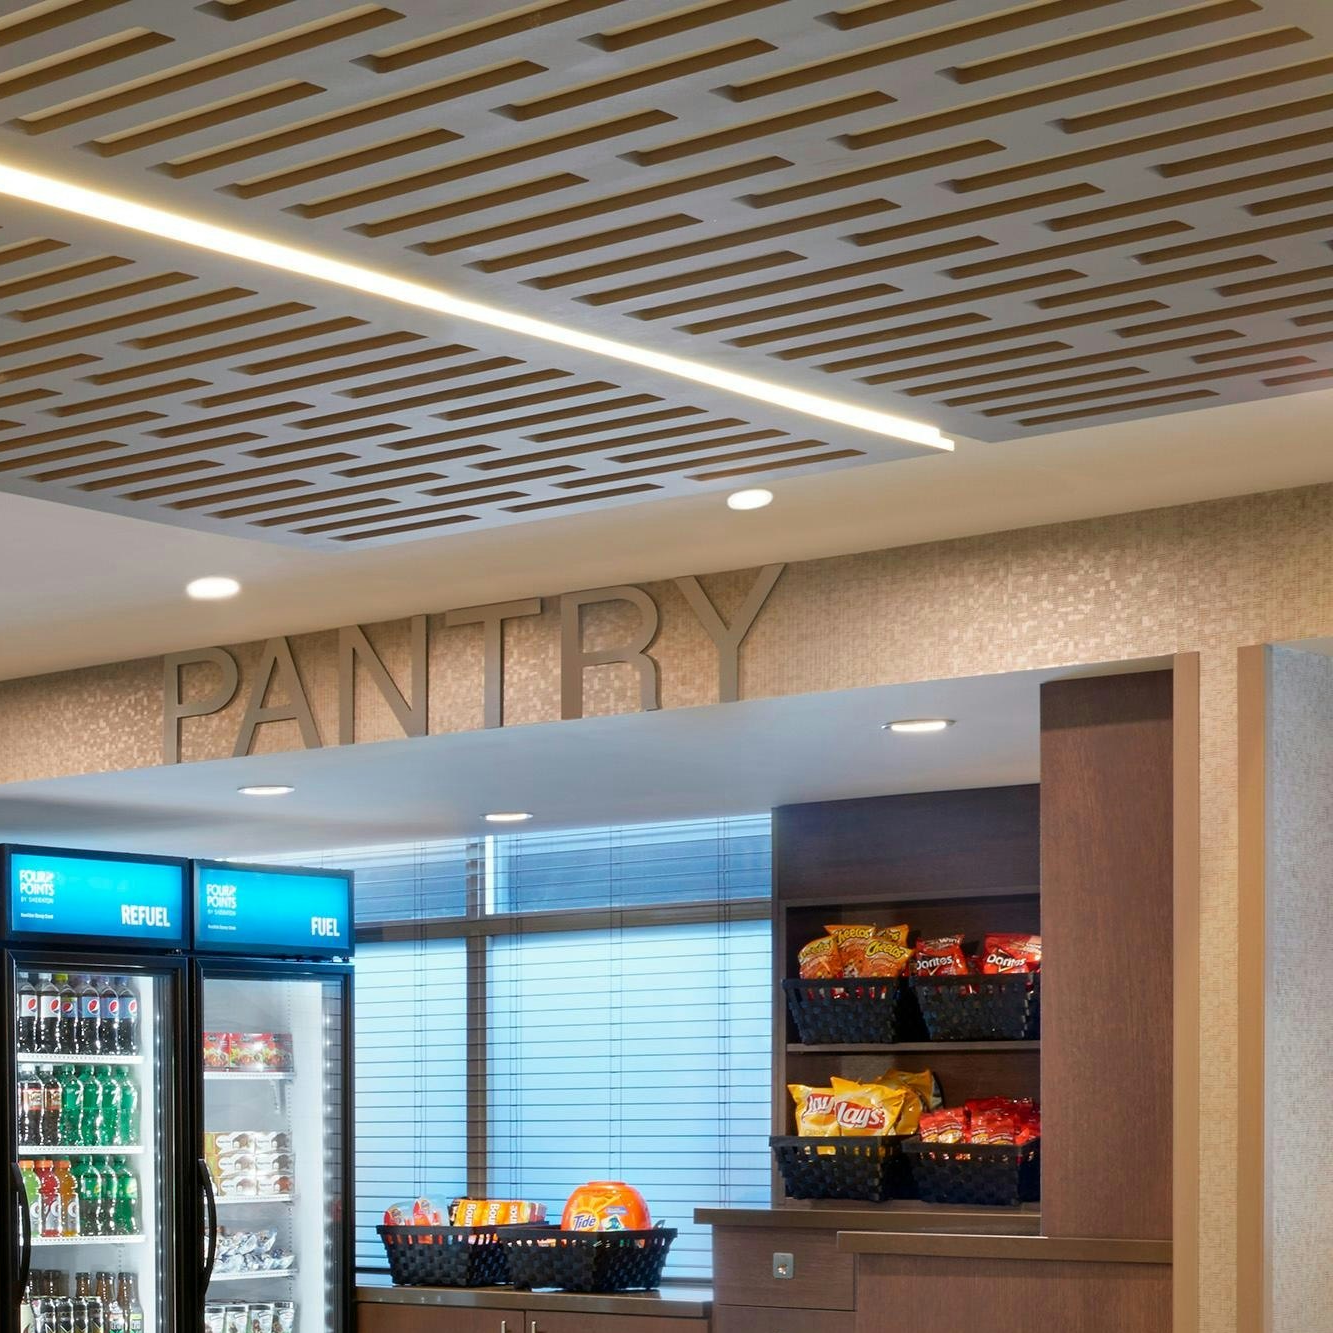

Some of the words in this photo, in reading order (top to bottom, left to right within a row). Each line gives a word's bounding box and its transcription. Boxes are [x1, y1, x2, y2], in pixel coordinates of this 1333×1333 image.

[163, 563, 787, 764] PANTRY
[20, 869, 49, 882] FOUR
[20, 882, 54, 896] POINTS
[206, 884, 232, 896] FOUR
[207, 896, 237, 909] POINTS
[121, 904, 170, 927] REFUEL
[311, 917, 340, 936] FUEL
[837, 927, 870, 945] heetos
[866, 940, 904, 958] Cheetos
[987, 953, 1026, 968] Doritos
[464, 1203, 476, 1226] Boun
[574, 1214, 596, 1231] Tide
